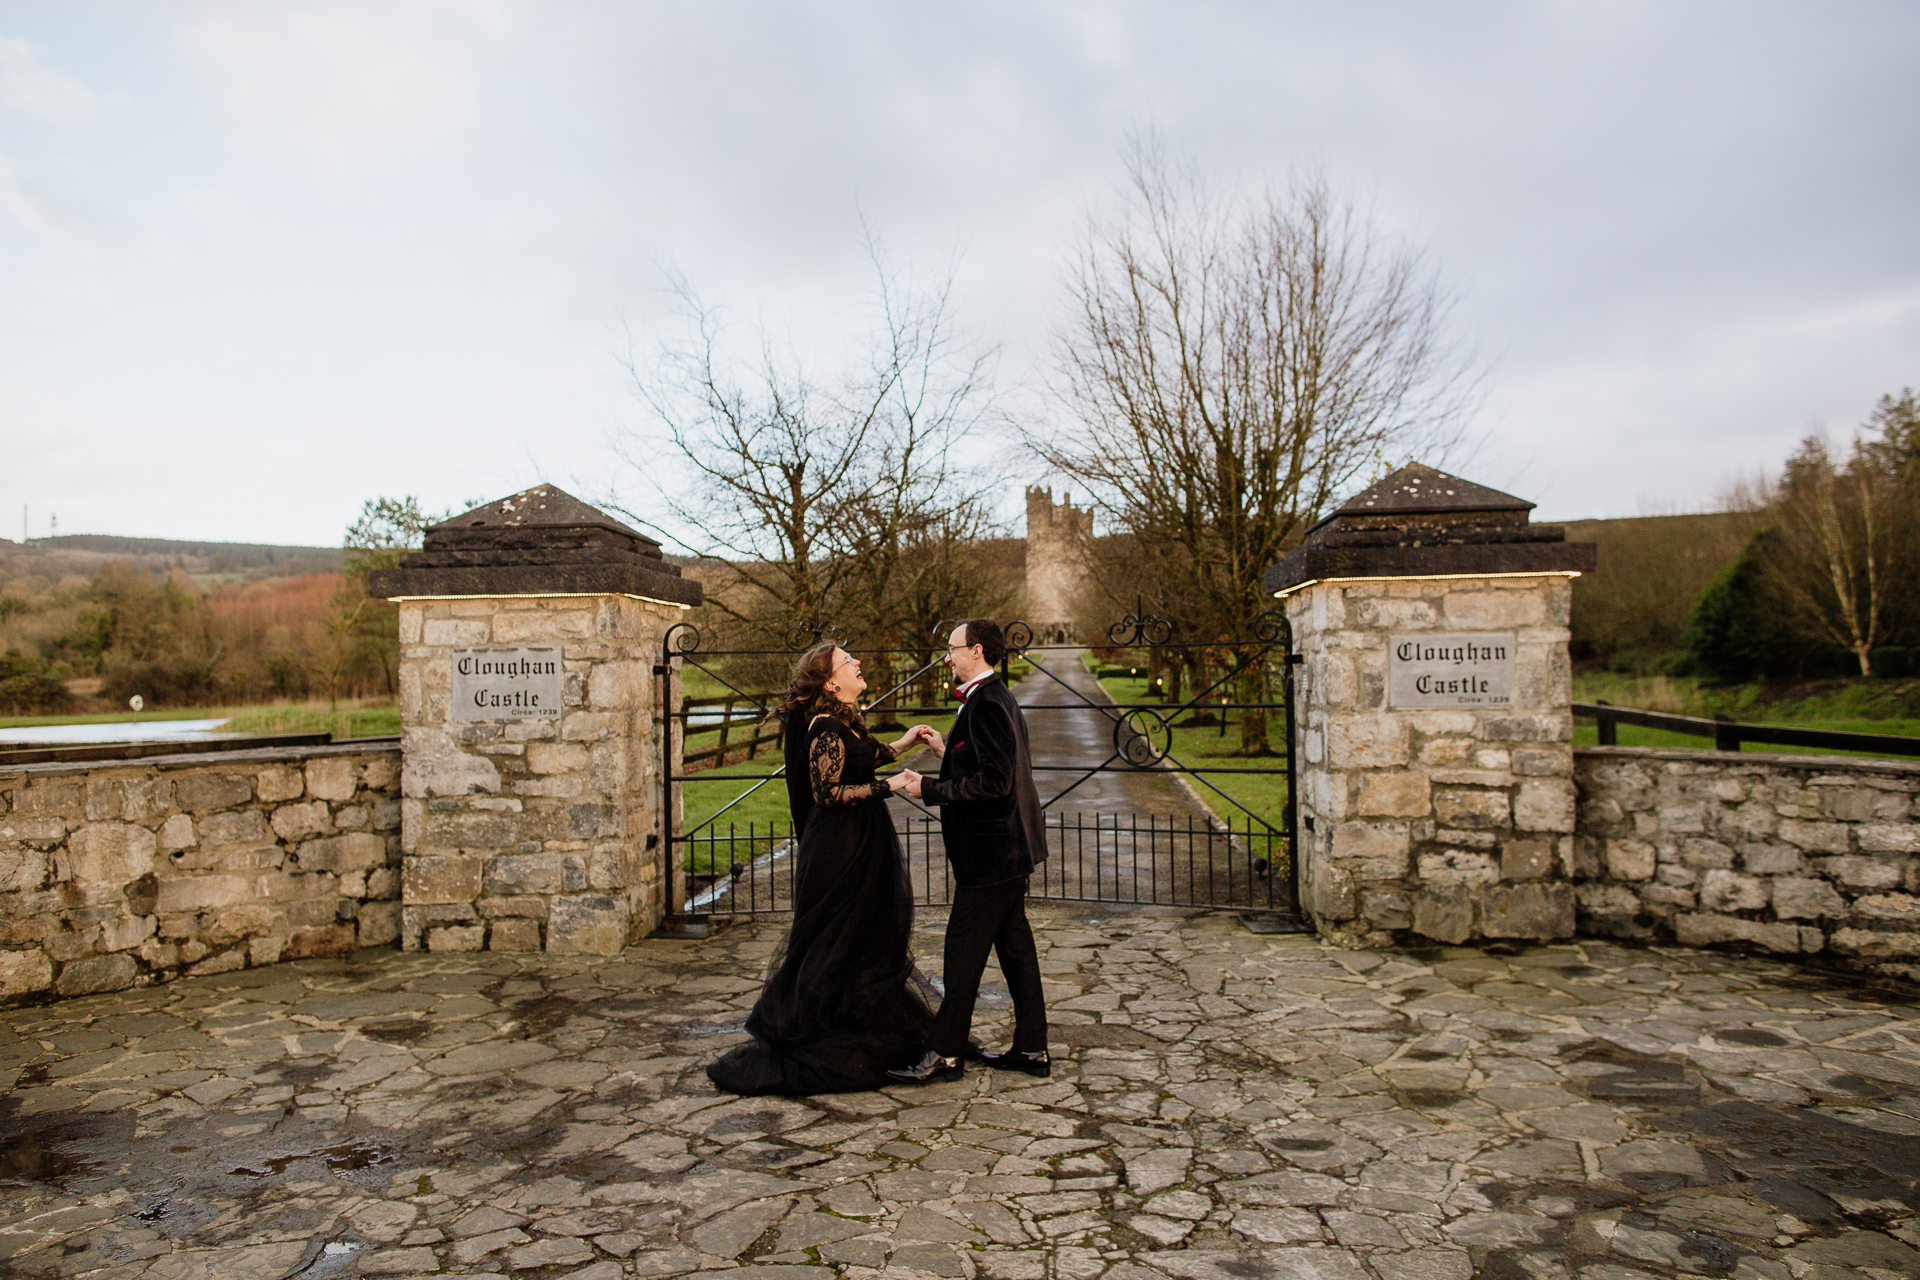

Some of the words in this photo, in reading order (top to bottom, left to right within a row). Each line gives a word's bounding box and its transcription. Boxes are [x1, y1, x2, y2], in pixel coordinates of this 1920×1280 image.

[1397, 642, 1506, 665] Cloughan
[458, 657, 556, 679] Cloughan
[1416, 675, 1489, 694] Castle
[474, 689, 539, 707] Castle
